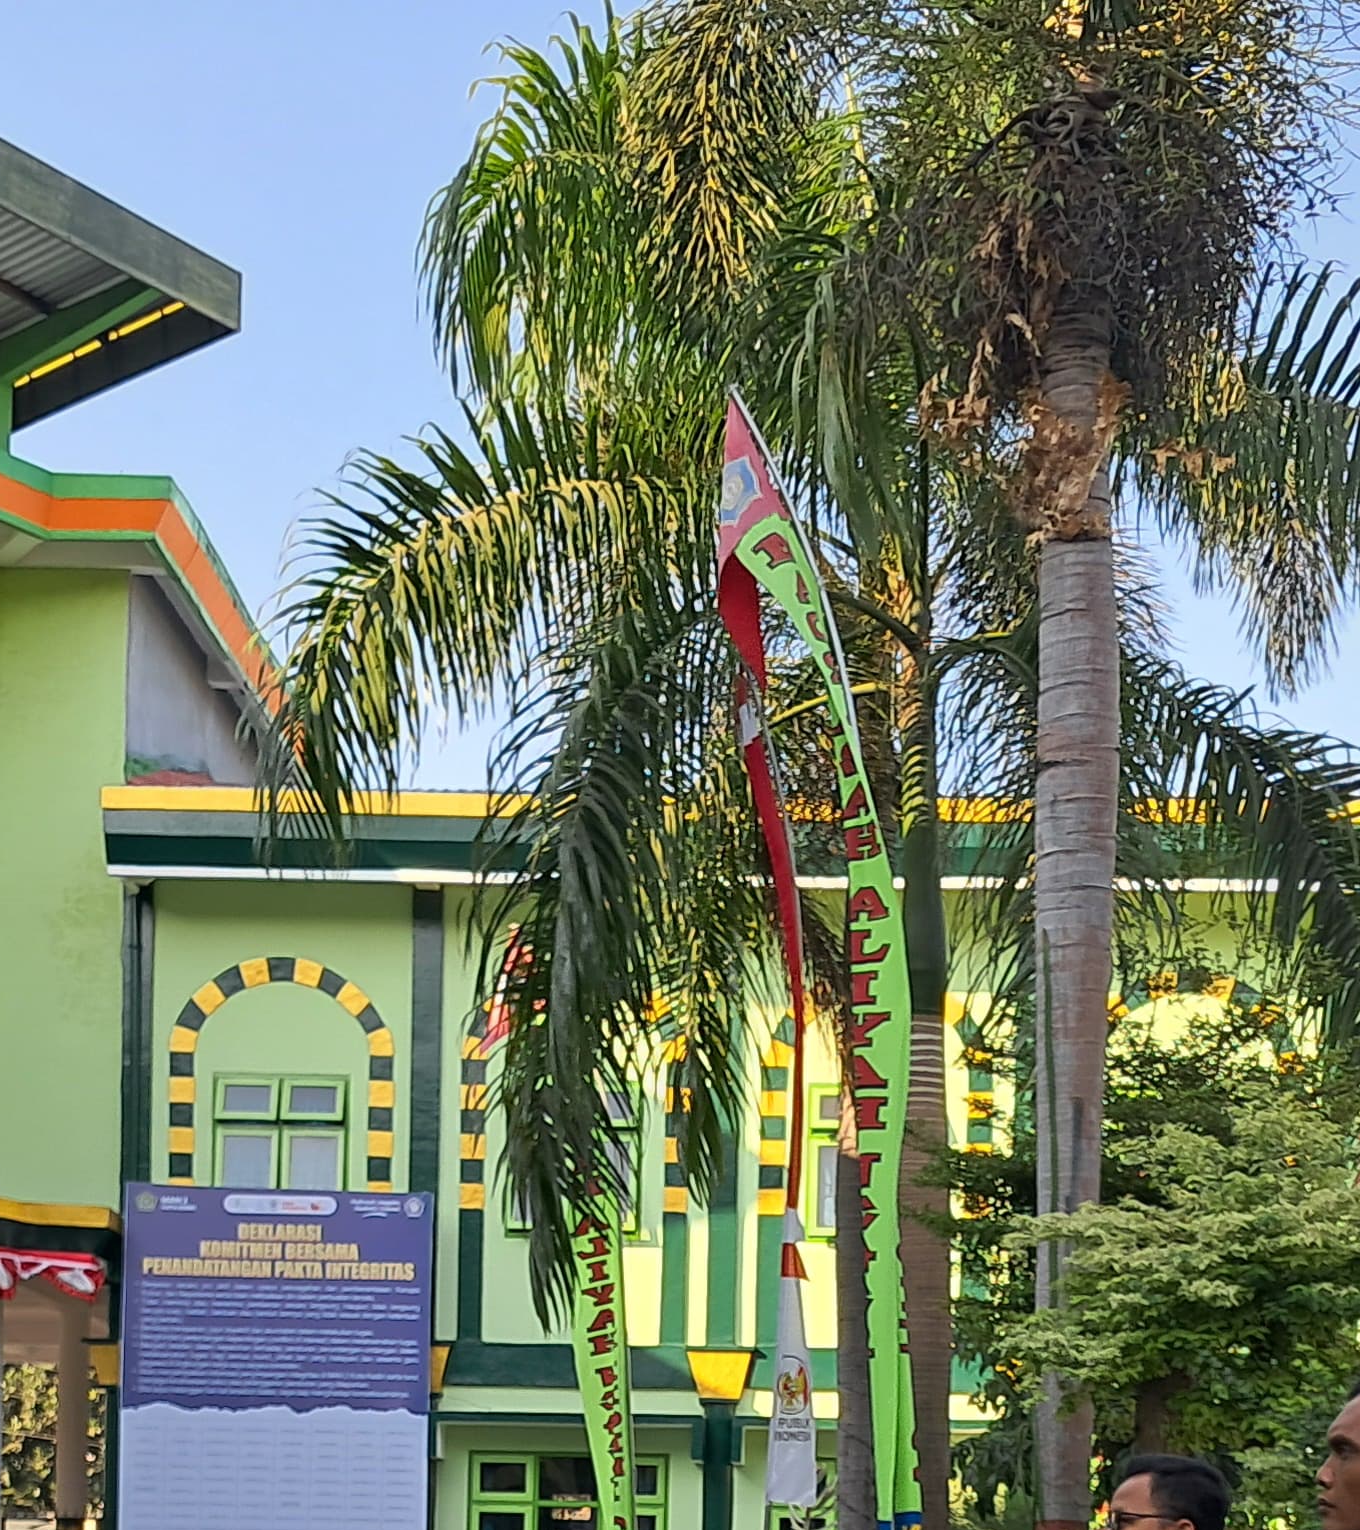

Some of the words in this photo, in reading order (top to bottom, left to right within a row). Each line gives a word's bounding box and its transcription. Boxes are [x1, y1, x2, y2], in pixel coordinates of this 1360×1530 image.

[237, 1222, 323, 1243] DEKLARASI
[200, 1240, 283, 1259] KOMITMEN
[285, 1241, 360, 1261] BERSAMA
[274, 1261, 323, 1280] PAKTA
[325, 1262, 416, 1282] INTEGRITAS
